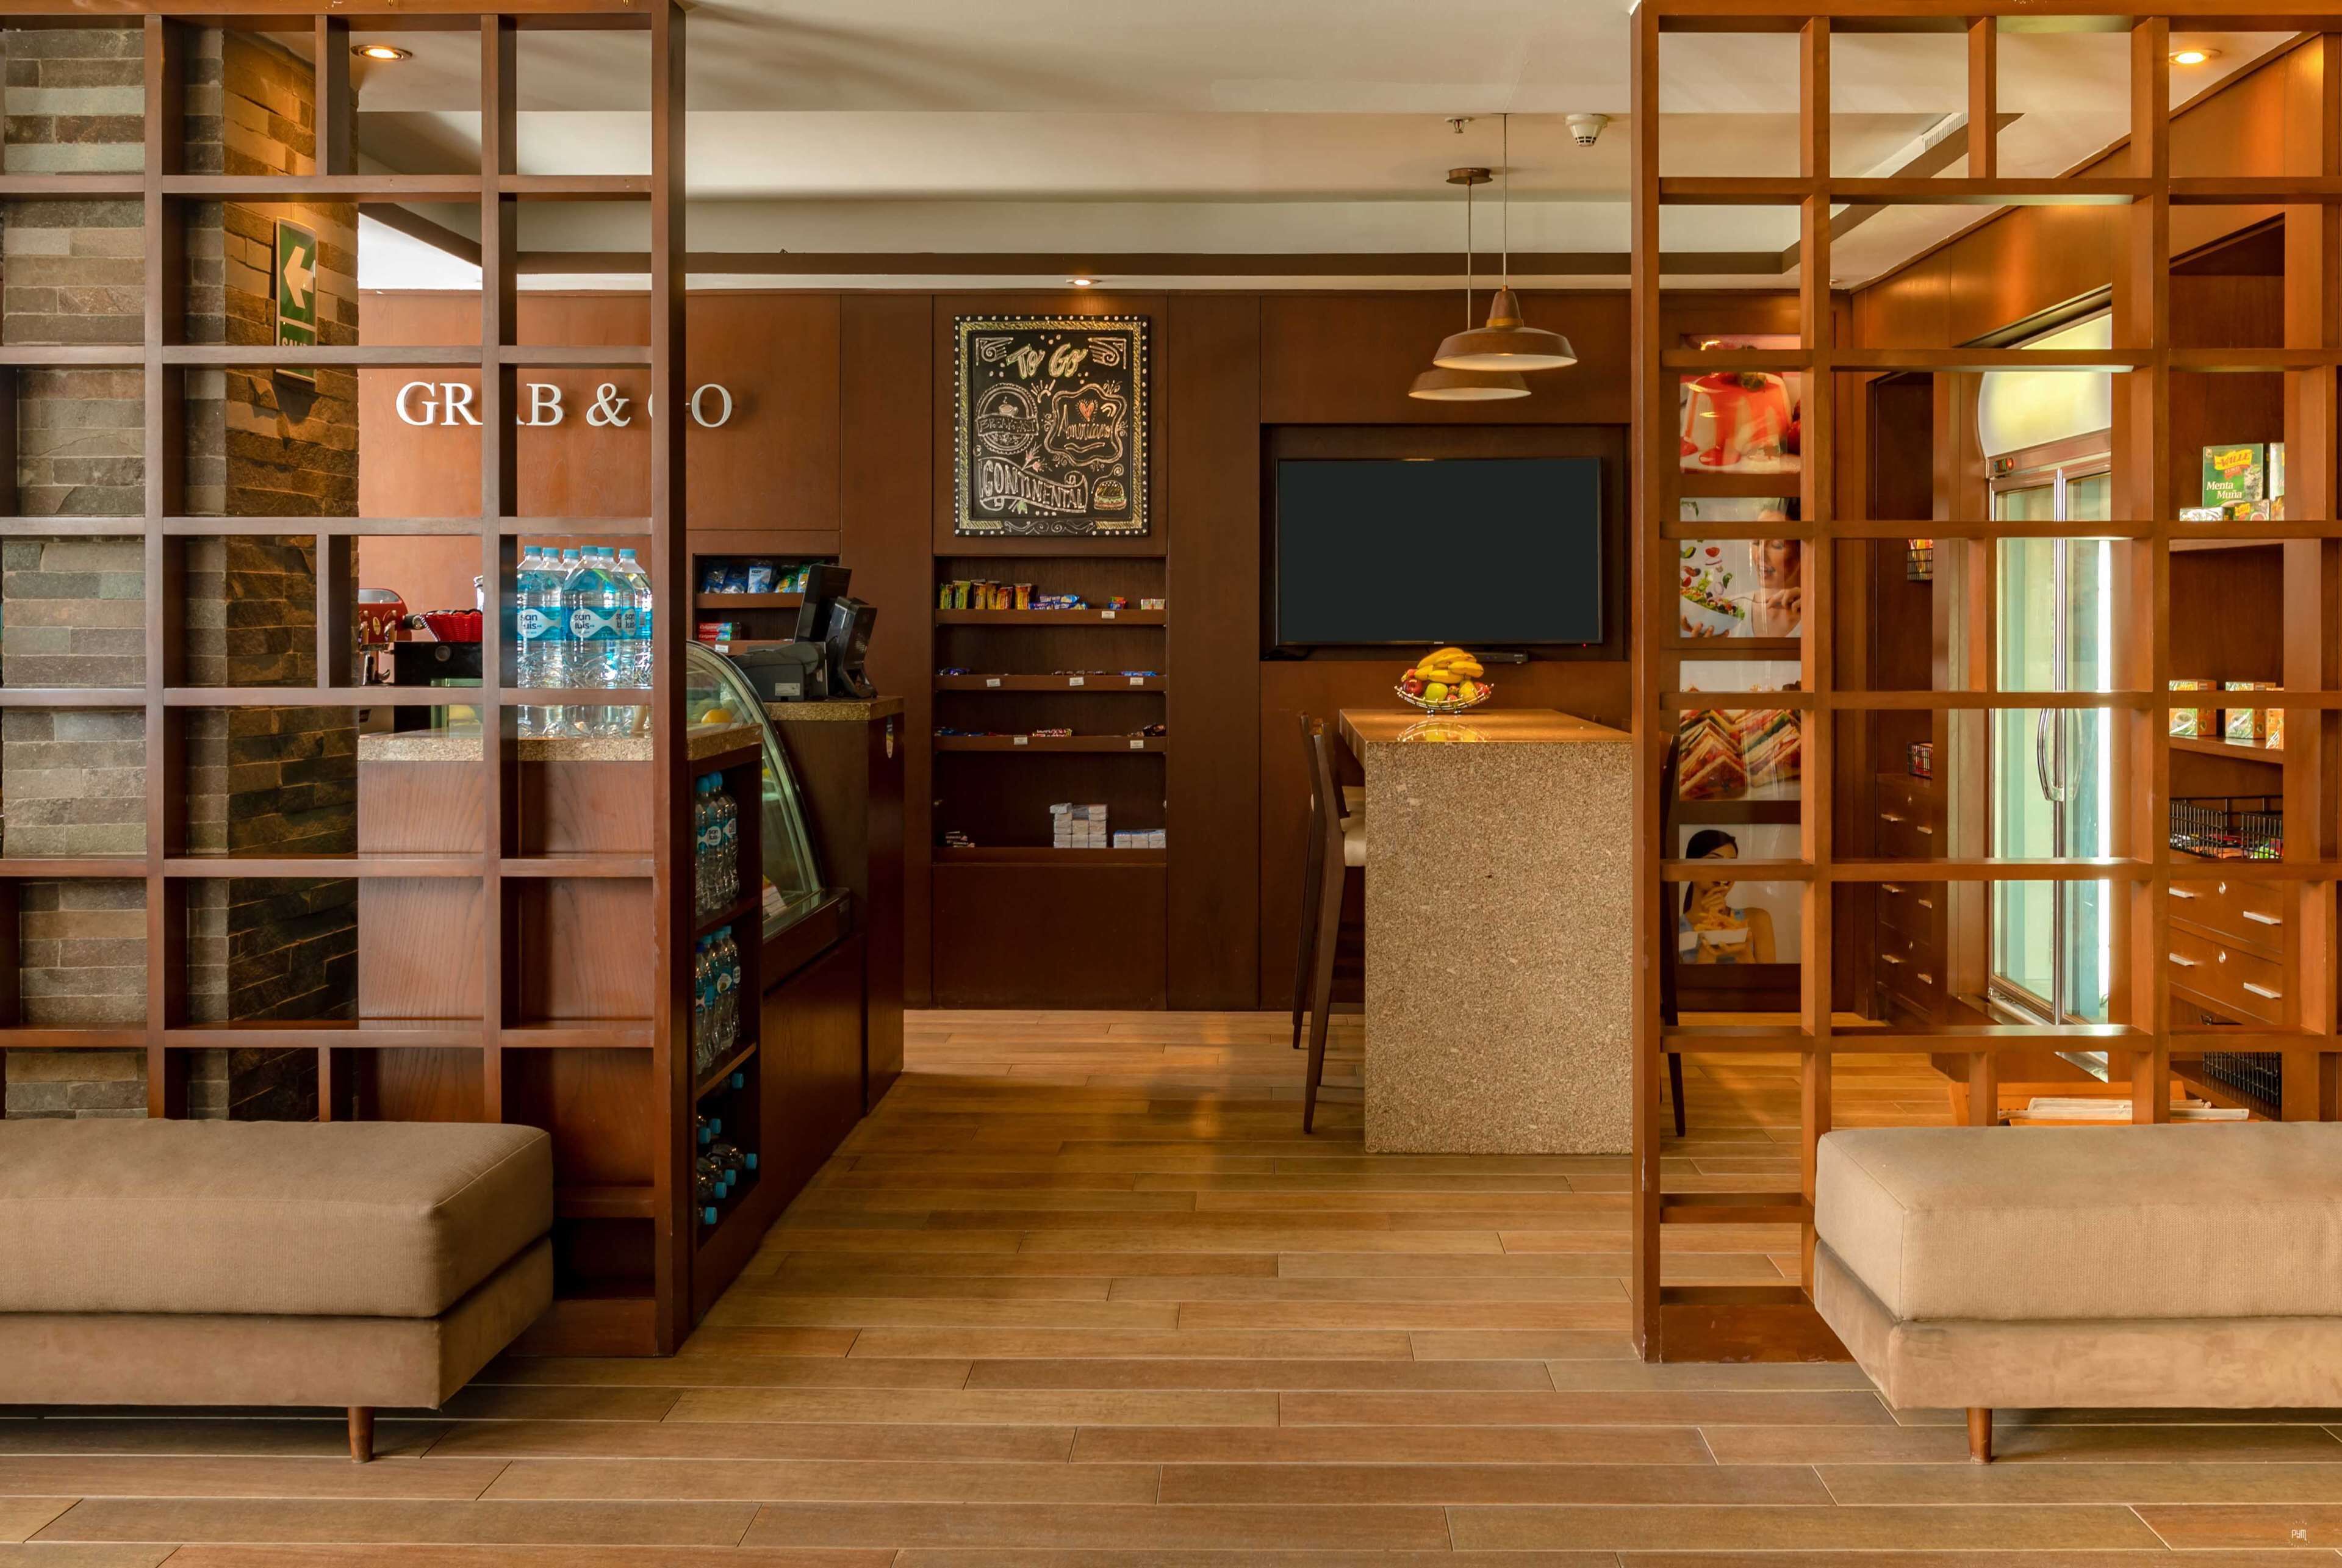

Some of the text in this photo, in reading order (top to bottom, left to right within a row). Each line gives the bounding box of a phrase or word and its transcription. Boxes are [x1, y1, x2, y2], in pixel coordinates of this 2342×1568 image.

[395, 381, 564, 426] GRB
[586, 383, 631, 427] &
[979, 417, 1035, 433] BREAKFAST
[982, 460, 1085, 509] CONTINENTAL
[2206, 481, 2233, 490] Menta
